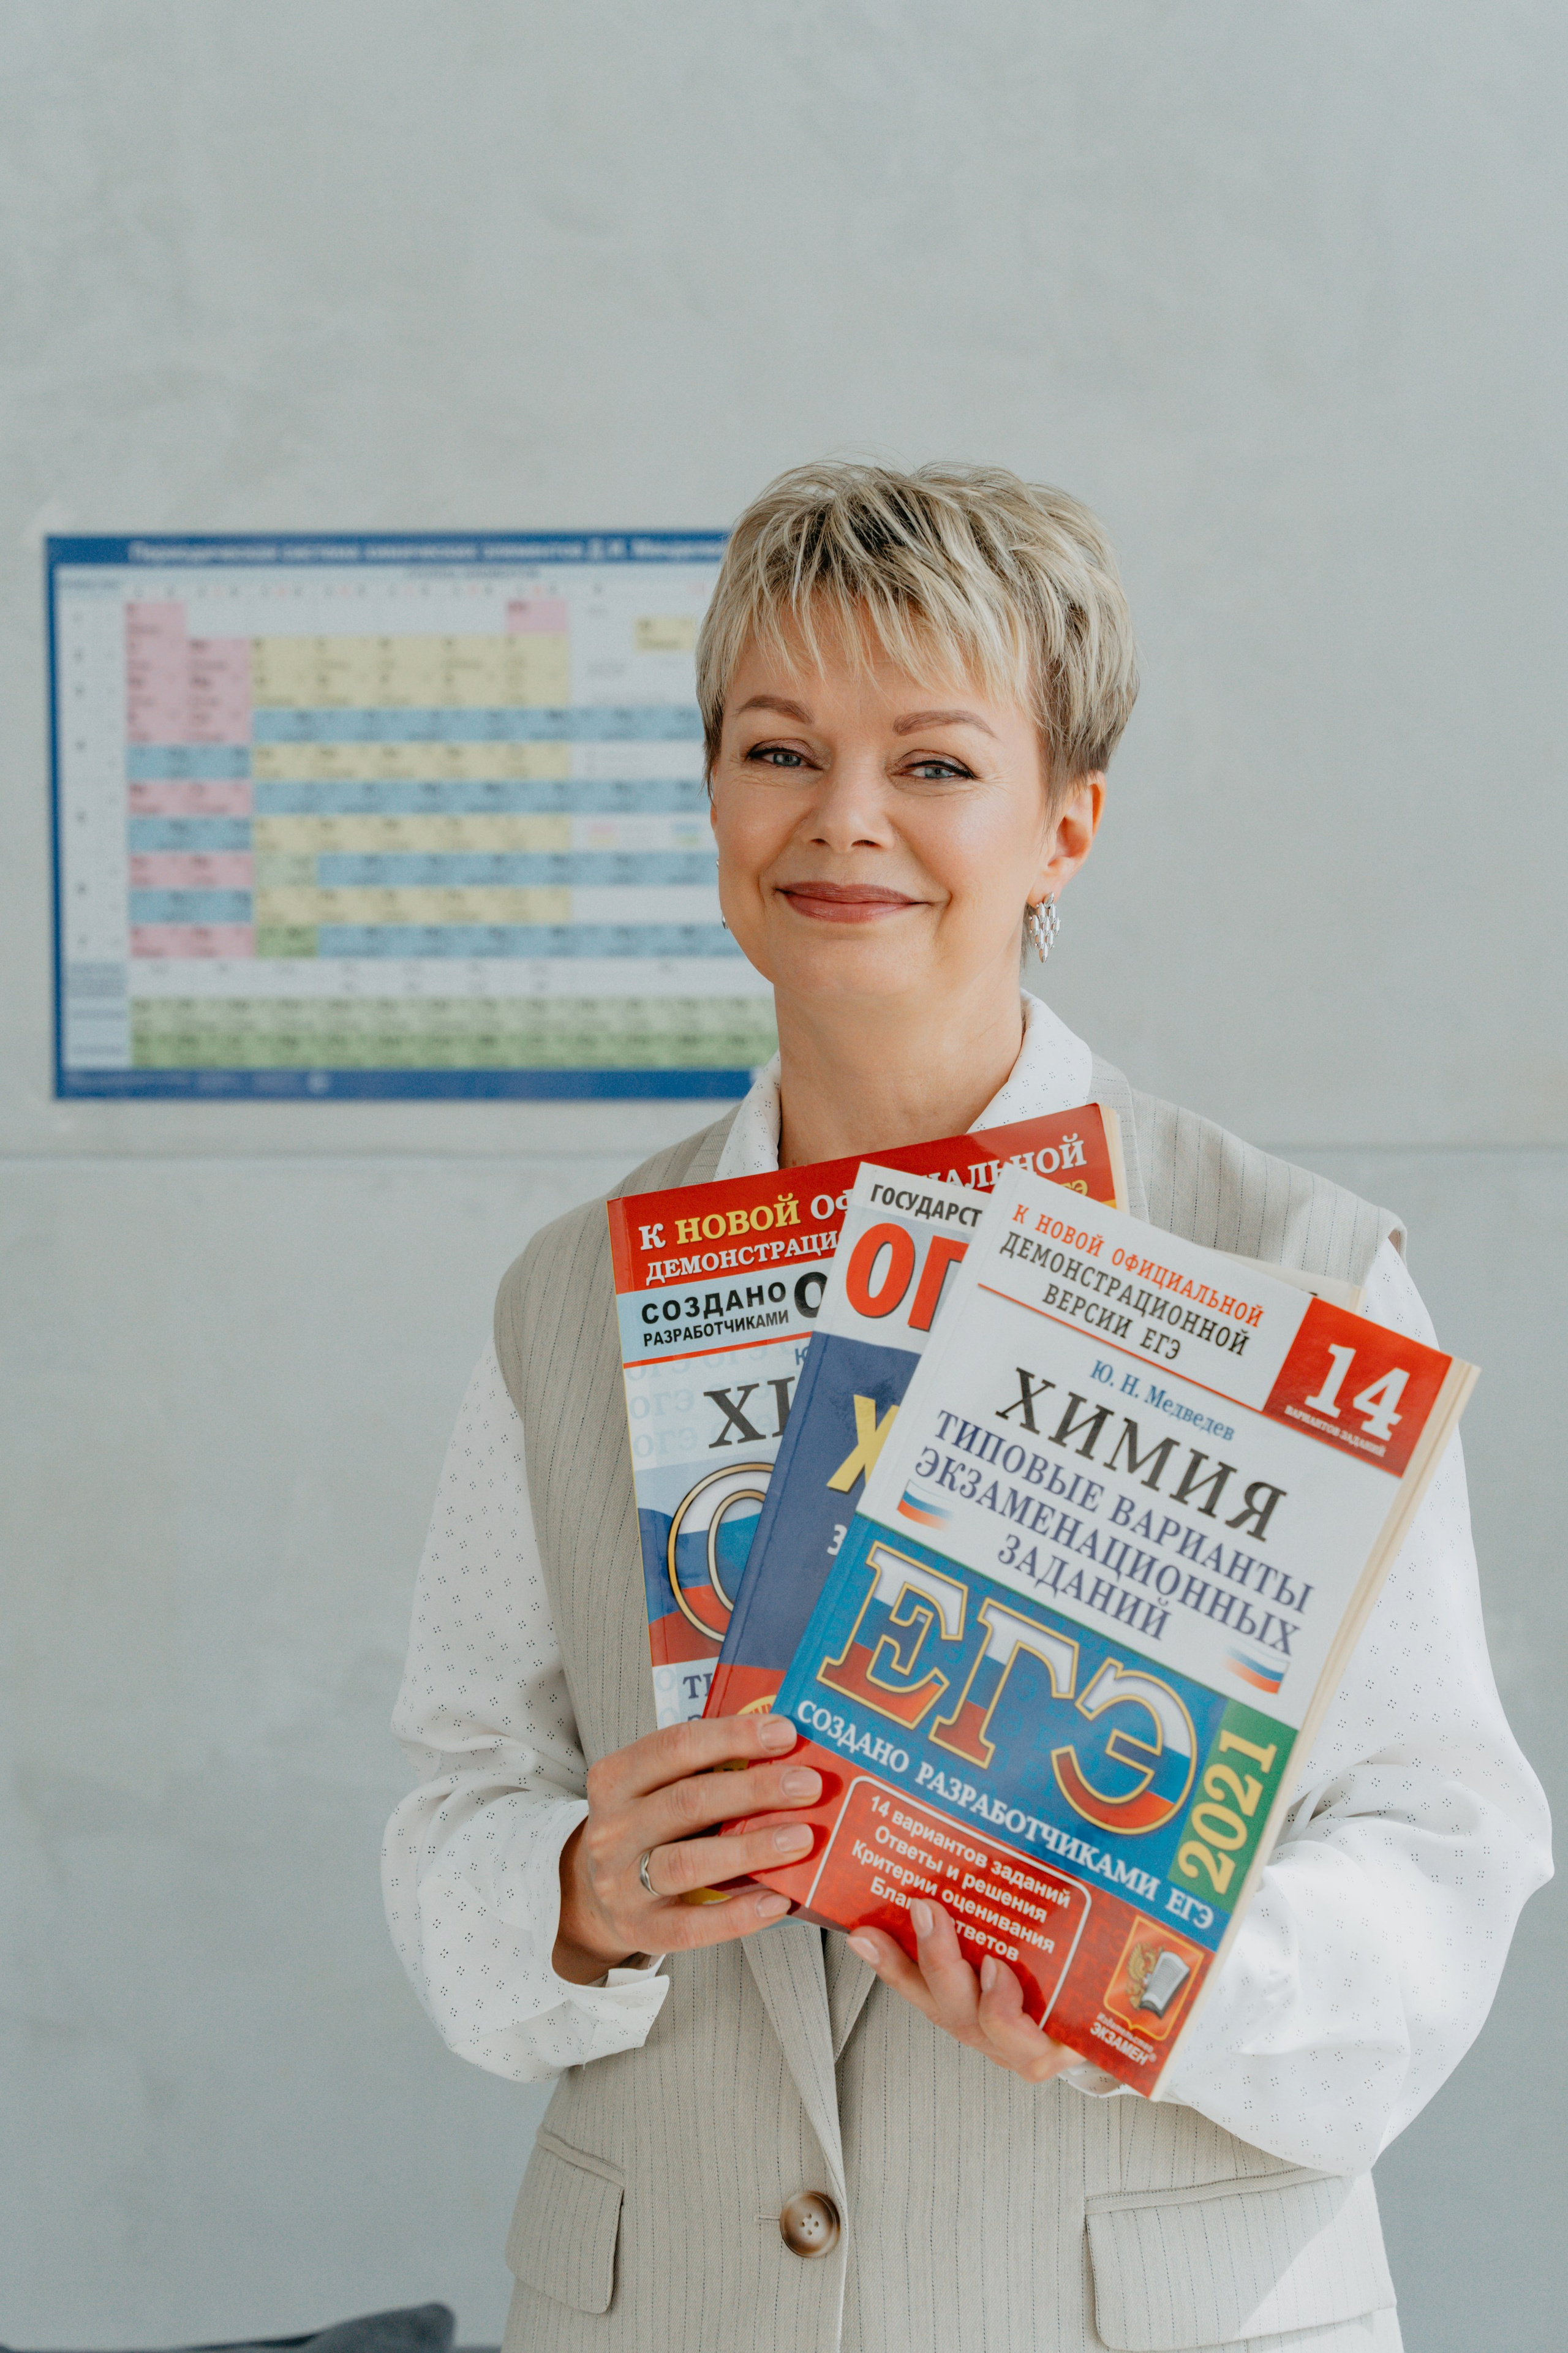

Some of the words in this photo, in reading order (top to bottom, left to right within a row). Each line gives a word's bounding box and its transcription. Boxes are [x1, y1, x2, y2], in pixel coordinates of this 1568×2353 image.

[639, 1223, 666, 1250] К
[675, 1193, 801, 1244] НОВОЙ
[646, 1231, 838, 1286] ДЕМОНСТРАЦИ
[870, 1184, 982, 1227] ГОСУДАРСТ
[642, 1282, 786, 1324] СОЗДАНО
[845, 1222, 969, 1332] ОГ
[1000, 1231, 1250, 1355] ДЕМОНСТРАЦИОННОЙ
[1012, 1204, 1030, 1225] К
[1035, 1214, 1105, 1257] НОВОЙ
[1112, 1248, 1264, 1328] ОФИЦИАЛЬНОЙ
[643, 1310, 789, 1346] РАЗРАБОТЧИКАМИ
[1042, 1283, 1133, 1339] ВЕРСИИ
[1140, 1328, 1181, 1359] ЕГЭ
[1090, 1359, 1114, 1387] Ю.
[1119, 1373, 1141, 1399] Н.
[1144, 1384, 1235, 1441] Медведев
[1304, 1343, 1410, 1441] 14
[995, 1367, 1287, 1542] ХИМИЯ
[916, 1446, 1301, 1655] ЭКЗАМЕНАЦИОННЫХ
[934, 1410, 1105, 1513] ТИПОВЫЕ
[1109, 1494, 1315, 1615] ВАРИАНТЫ
[998, 1533, 1171, 1641] ЗАДАНИЙ
[816, 1540, 1197, 1835] ЕГЭ
[797, 1700, 910, 1773] СОЗДАНО
[915, 1761, 1160, 1902] РАЗРАБОТЧИКАМИ
[1165, 1887, 1214, 1929] ЕГЭ
[872, 1796, 888, 1817] 14
[892, 1810, 988, 1868] вариантов
[991, 1860, 1071, 1908] заданий
[1178, 1730, 1277, 1894] 2021
[852, 1839, 938, 1896] Критерии
[942, 1889, 1055, 1954] оценивания
[875, 1826, 943, 1873] Ответы
[946, 1867, 960, 1881] и
[962, 1873, 1047, 1924] решения
[950, 1916, 1019, 1962] тветов
